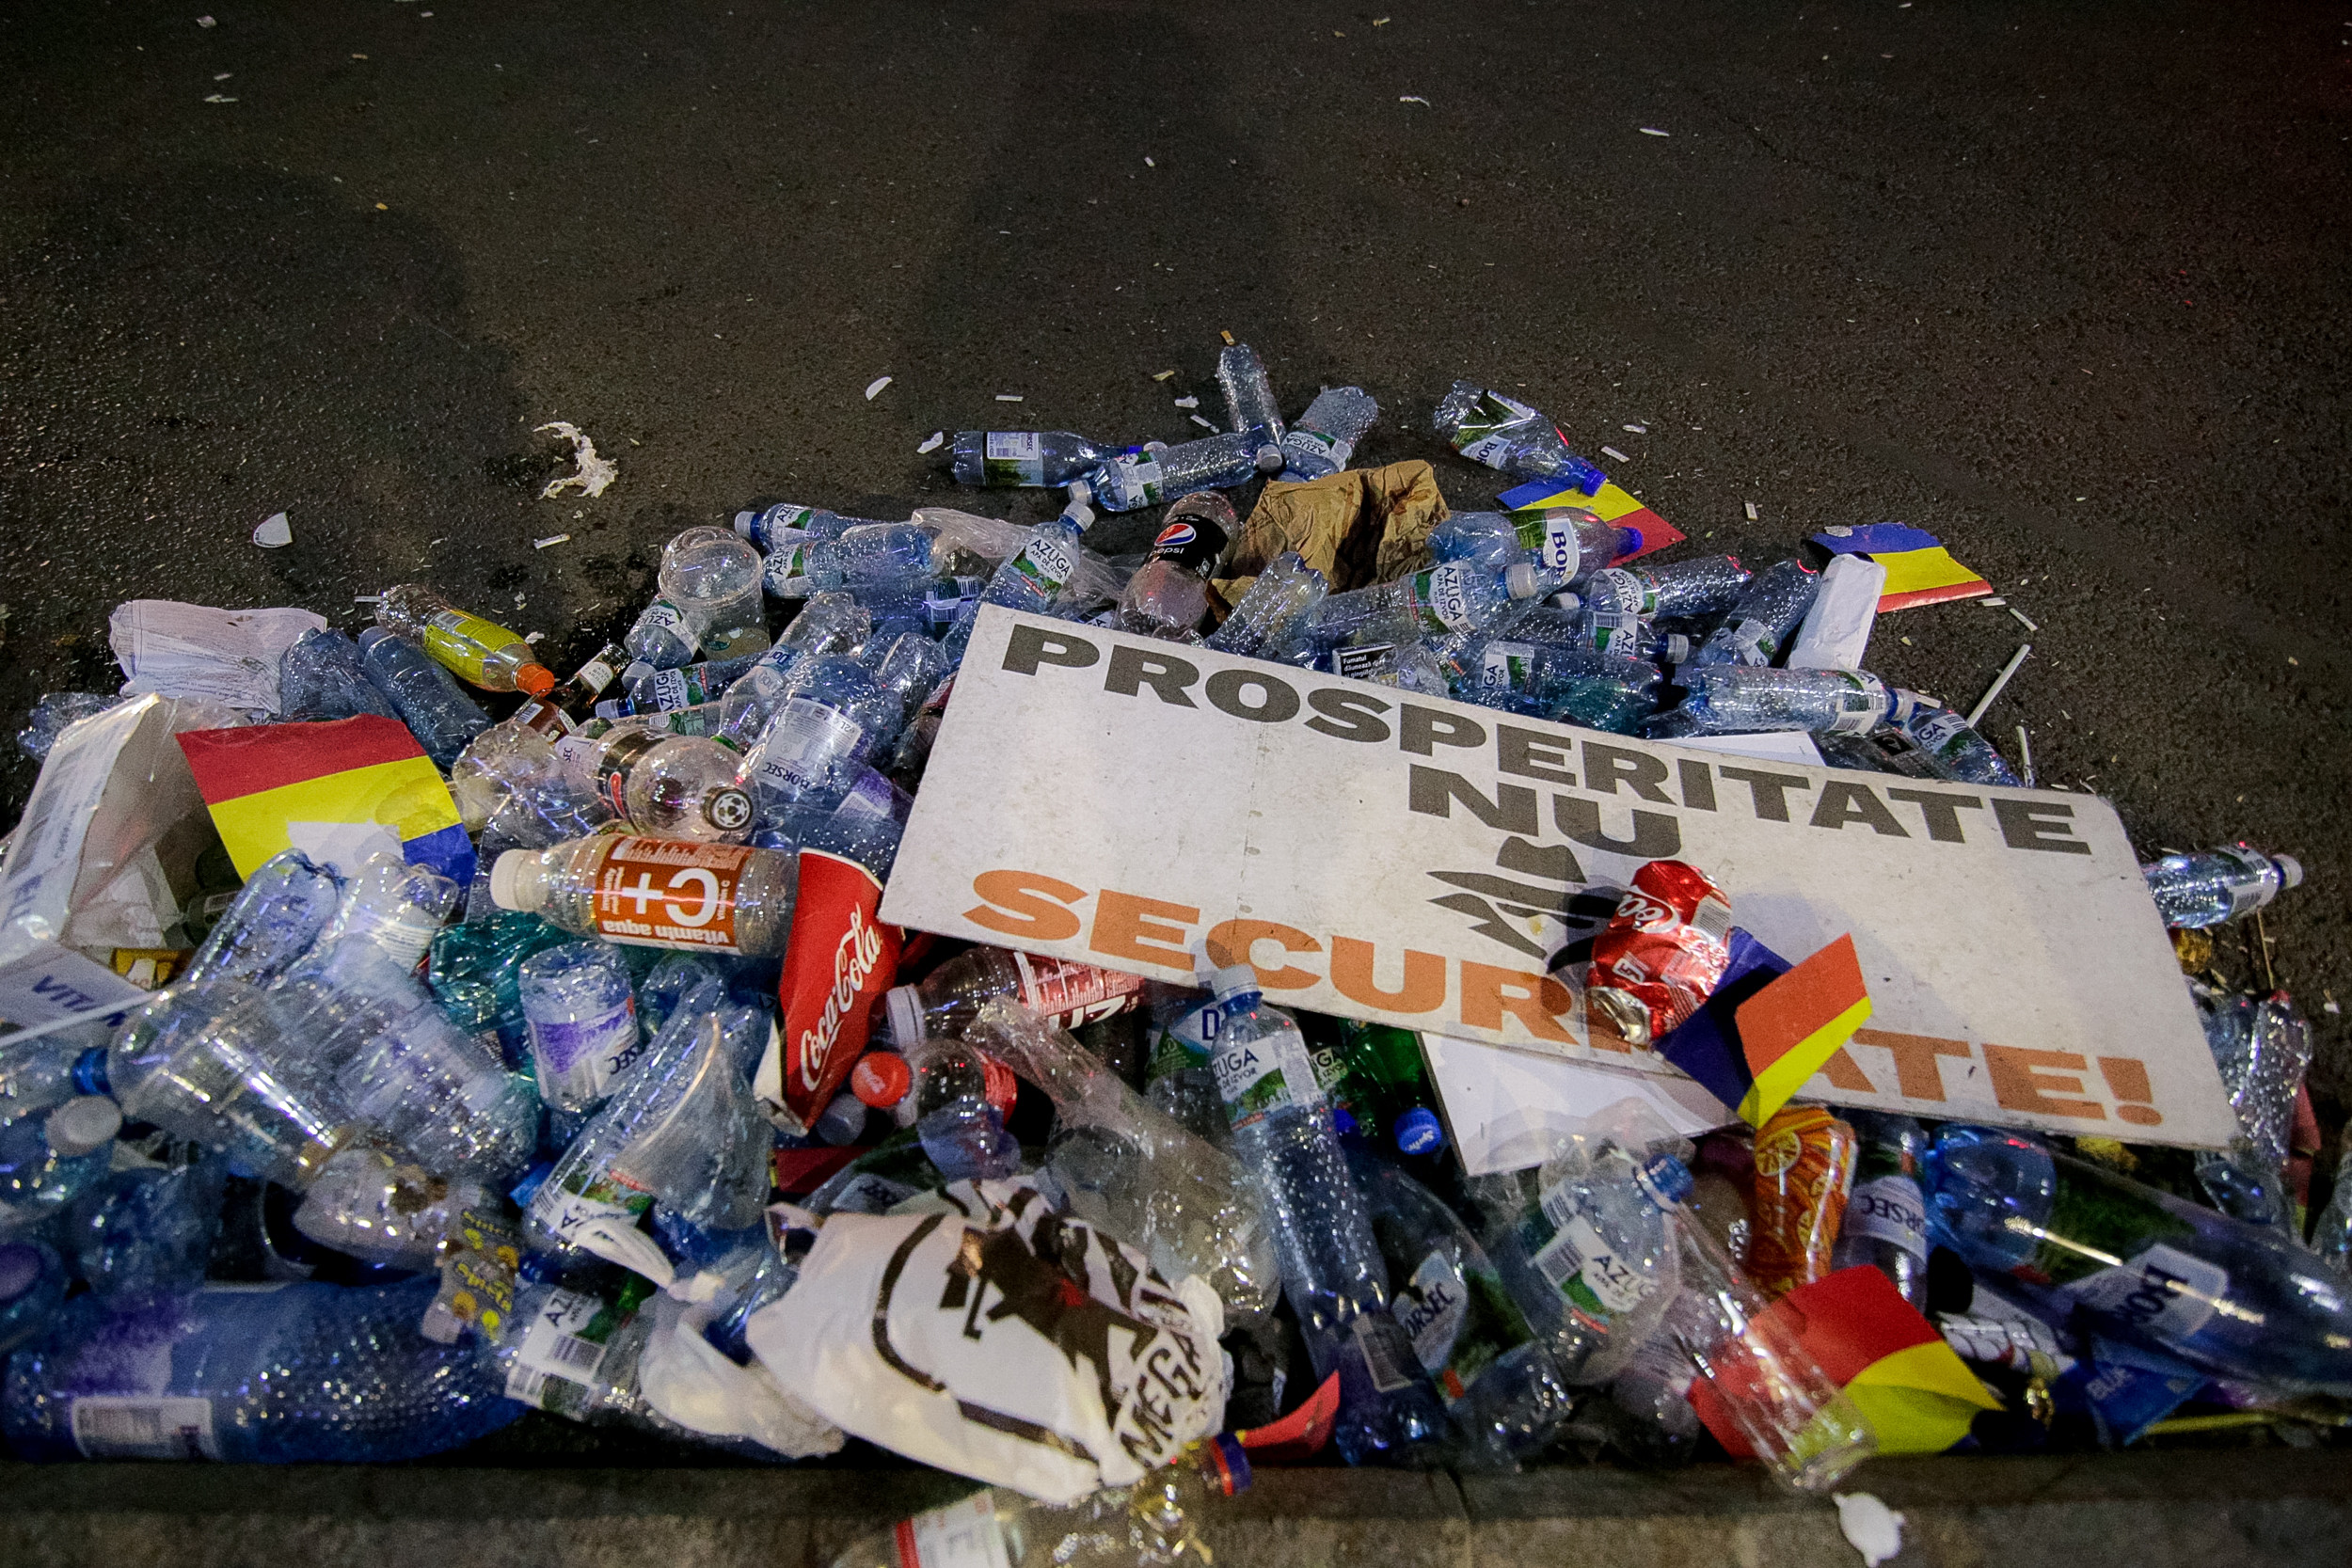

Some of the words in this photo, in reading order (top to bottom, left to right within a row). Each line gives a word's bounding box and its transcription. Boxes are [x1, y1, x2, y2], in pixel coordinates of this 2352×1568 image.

[1287, 435, 1327, 455] AZUGA
[1030, 538, 1072, 578] AZUGA
[1149, 546, 1185, 558] pepsi
[1443, 567, 1463, 622] AZUGA
[1610, 571, 1634, 614] AZUGA
[1343, 655, 1367, 664] Fumatul
[1001, 624, 2091, 856] PROSPERITATE
[762, 762, 810, 791] BORSEC
[1408, 762, 1681, 860] NU
[603, 920, 648, 936] aqua
[653, 926, 730, 943] vitamin
[800, 902, 881, 1092] Coca-Cola
[961, 869, 2162, 1126] SECURTE!
